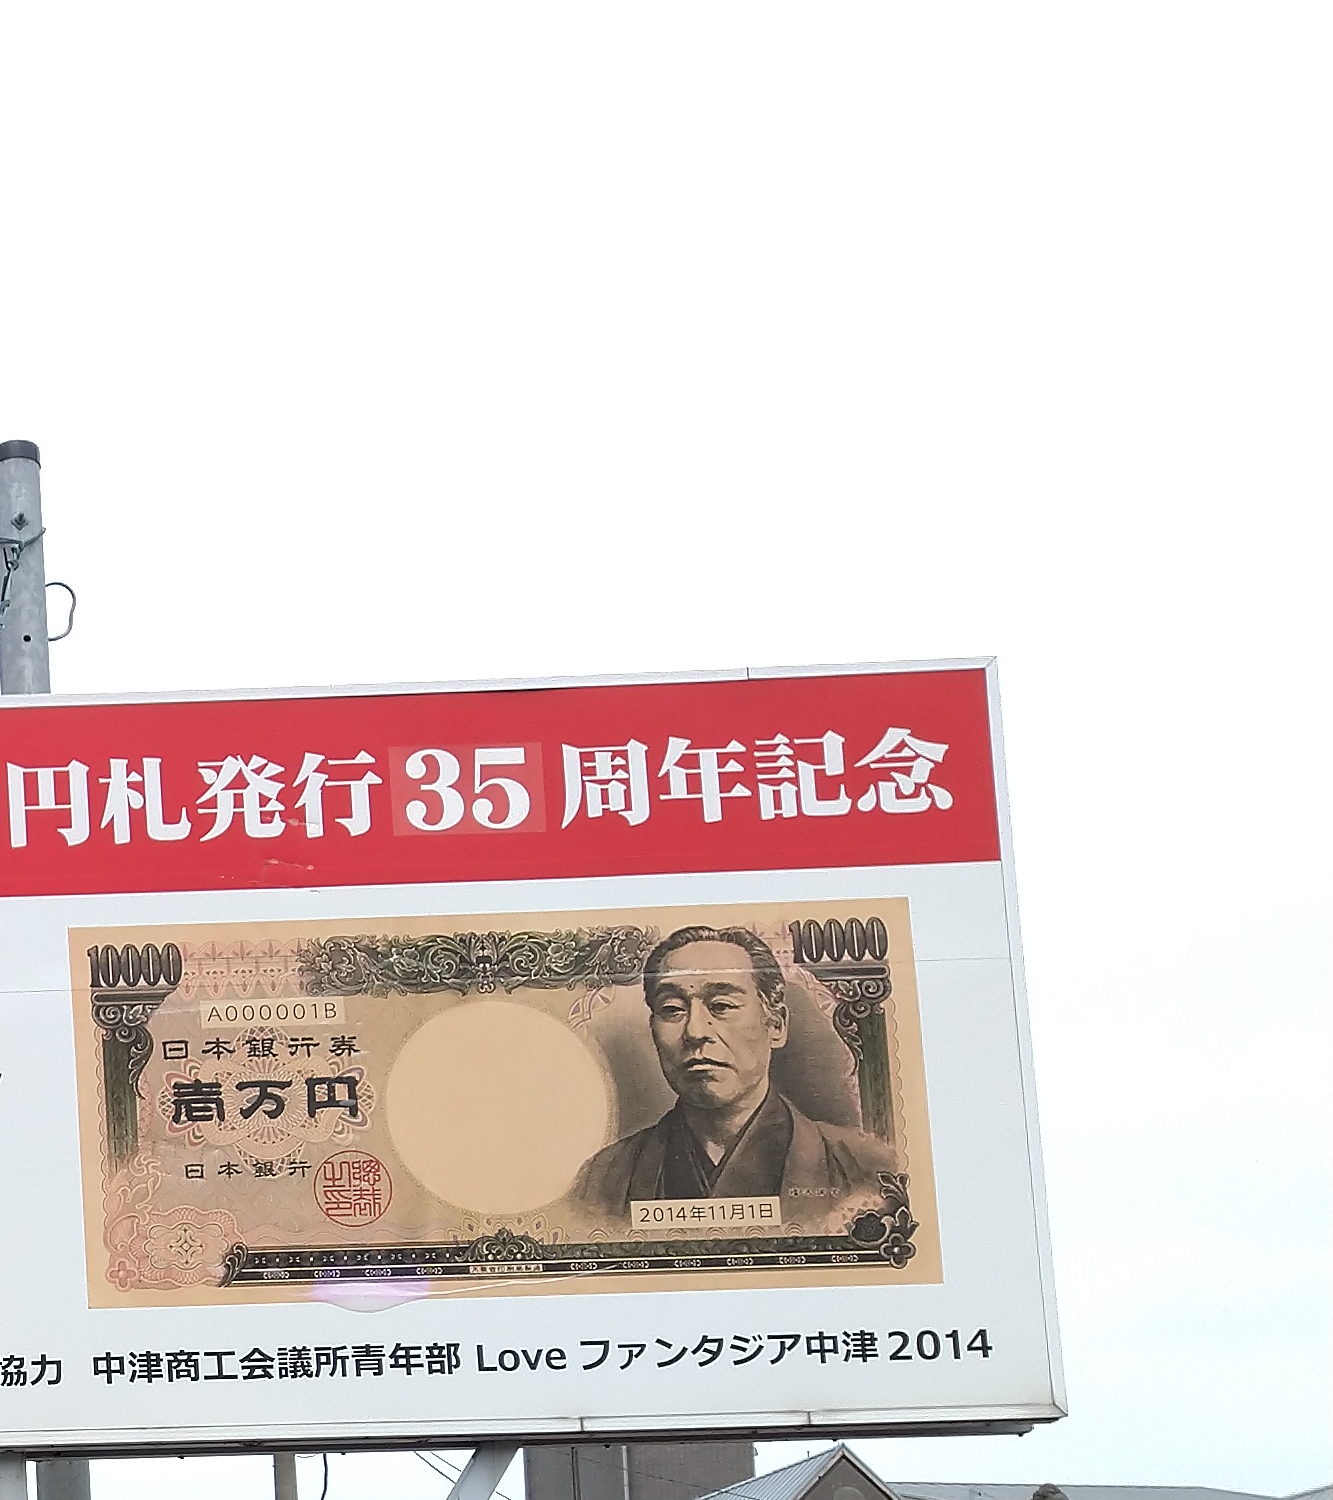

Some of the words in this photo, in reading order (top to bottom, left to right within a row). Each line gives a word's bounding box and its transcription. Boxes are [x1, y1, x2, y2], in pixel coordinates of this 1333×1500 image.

[789, 916, 888, 963] 10000
[86, 943, 184, 988] 10000
[207, 1002, 338, 1022] A000001B
[161, 1035, 361, 1060] 日本銀行券
[172, 1076, 359, 1123] 壱万円
[184, 1161, 312, 1180] 日本銀行
[639, 1203, 774, 1223] 2014年11月1日
[92, 1341, 461, 1386] 中津商工会議所青年部
[477, 1340, 566, 1374] Love
